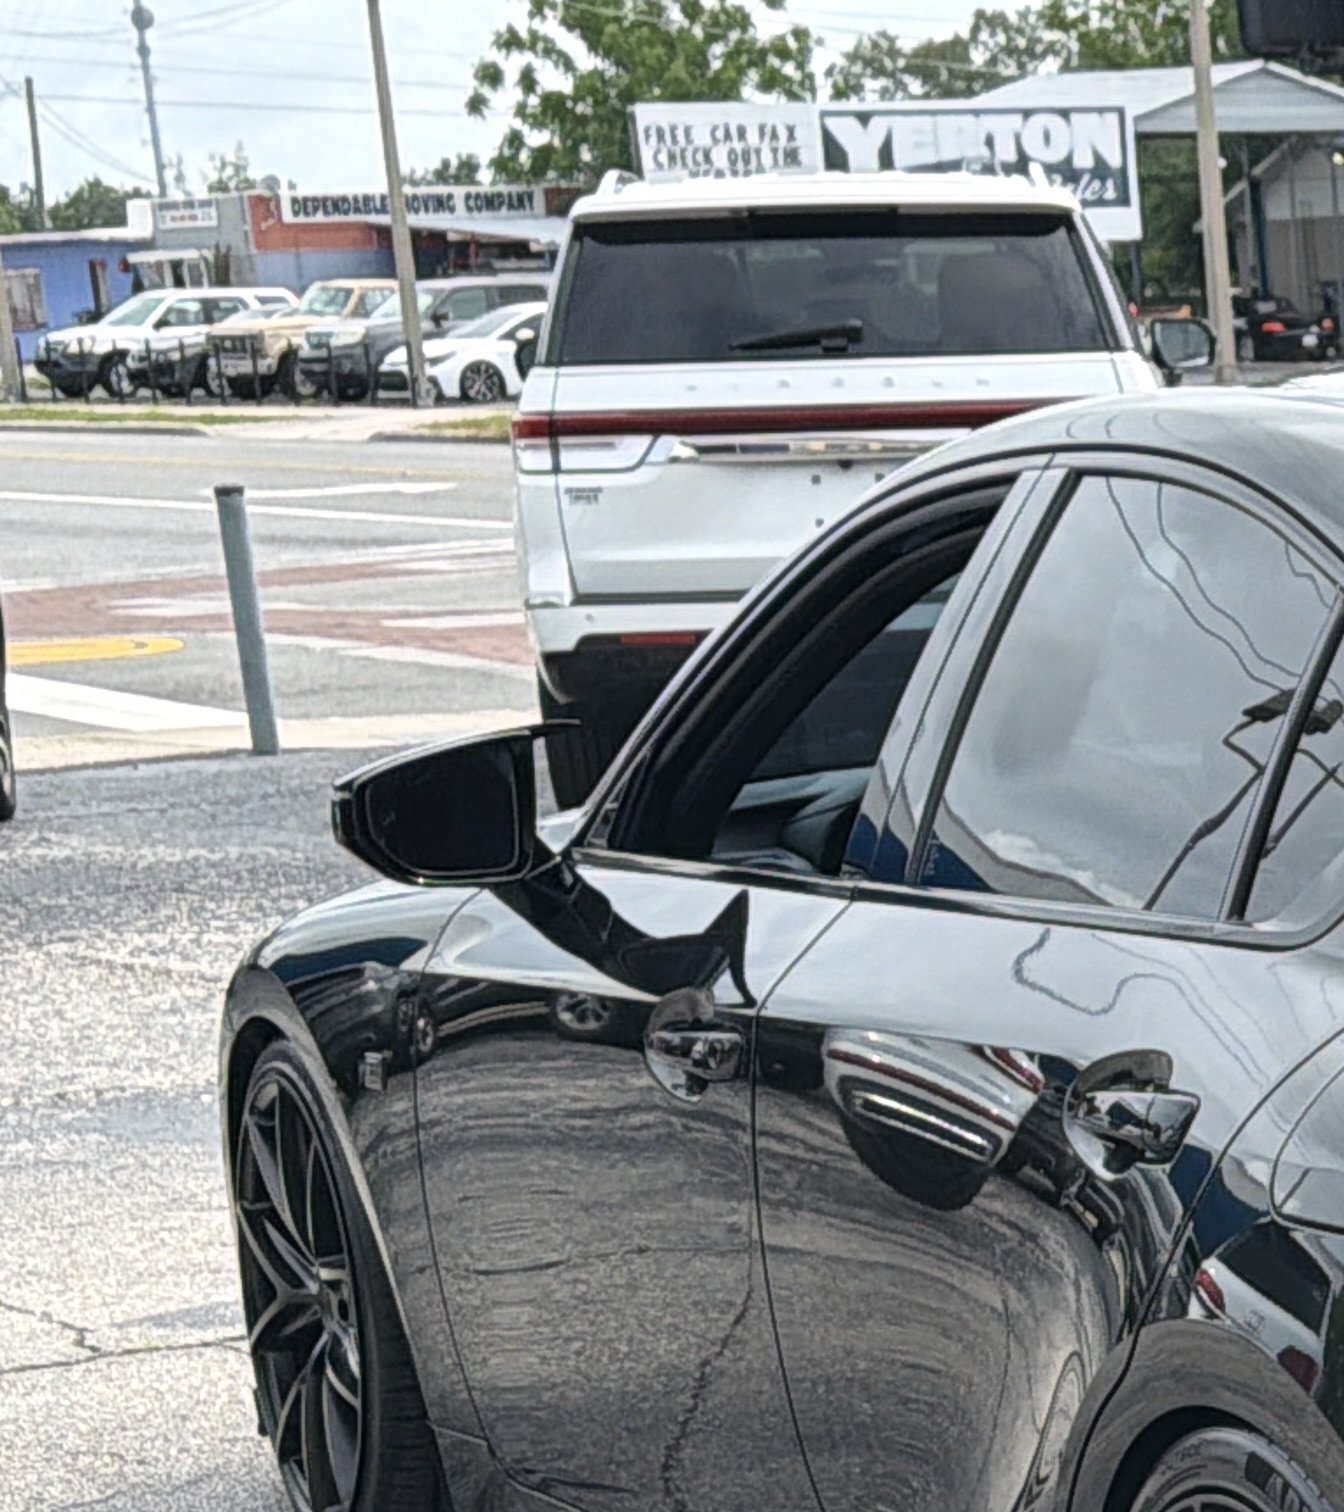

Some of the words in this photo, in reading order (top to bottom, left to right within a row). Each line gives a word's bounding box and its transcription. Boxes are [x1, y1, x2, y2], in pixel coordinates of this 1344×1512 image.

[643, 124, 694, 146] FREE
[710, 122, 749, 144] CAR
[758, 122, 797, 143] FAX
[824, 111, 1123, 173] YERTON
[652, 147, 714, 171] CHECK
[1050, 172, 1119, 201] les
[290, 193, 390, 217] DEPENDABLE
[464, 190, 535, 213] COMPANY
